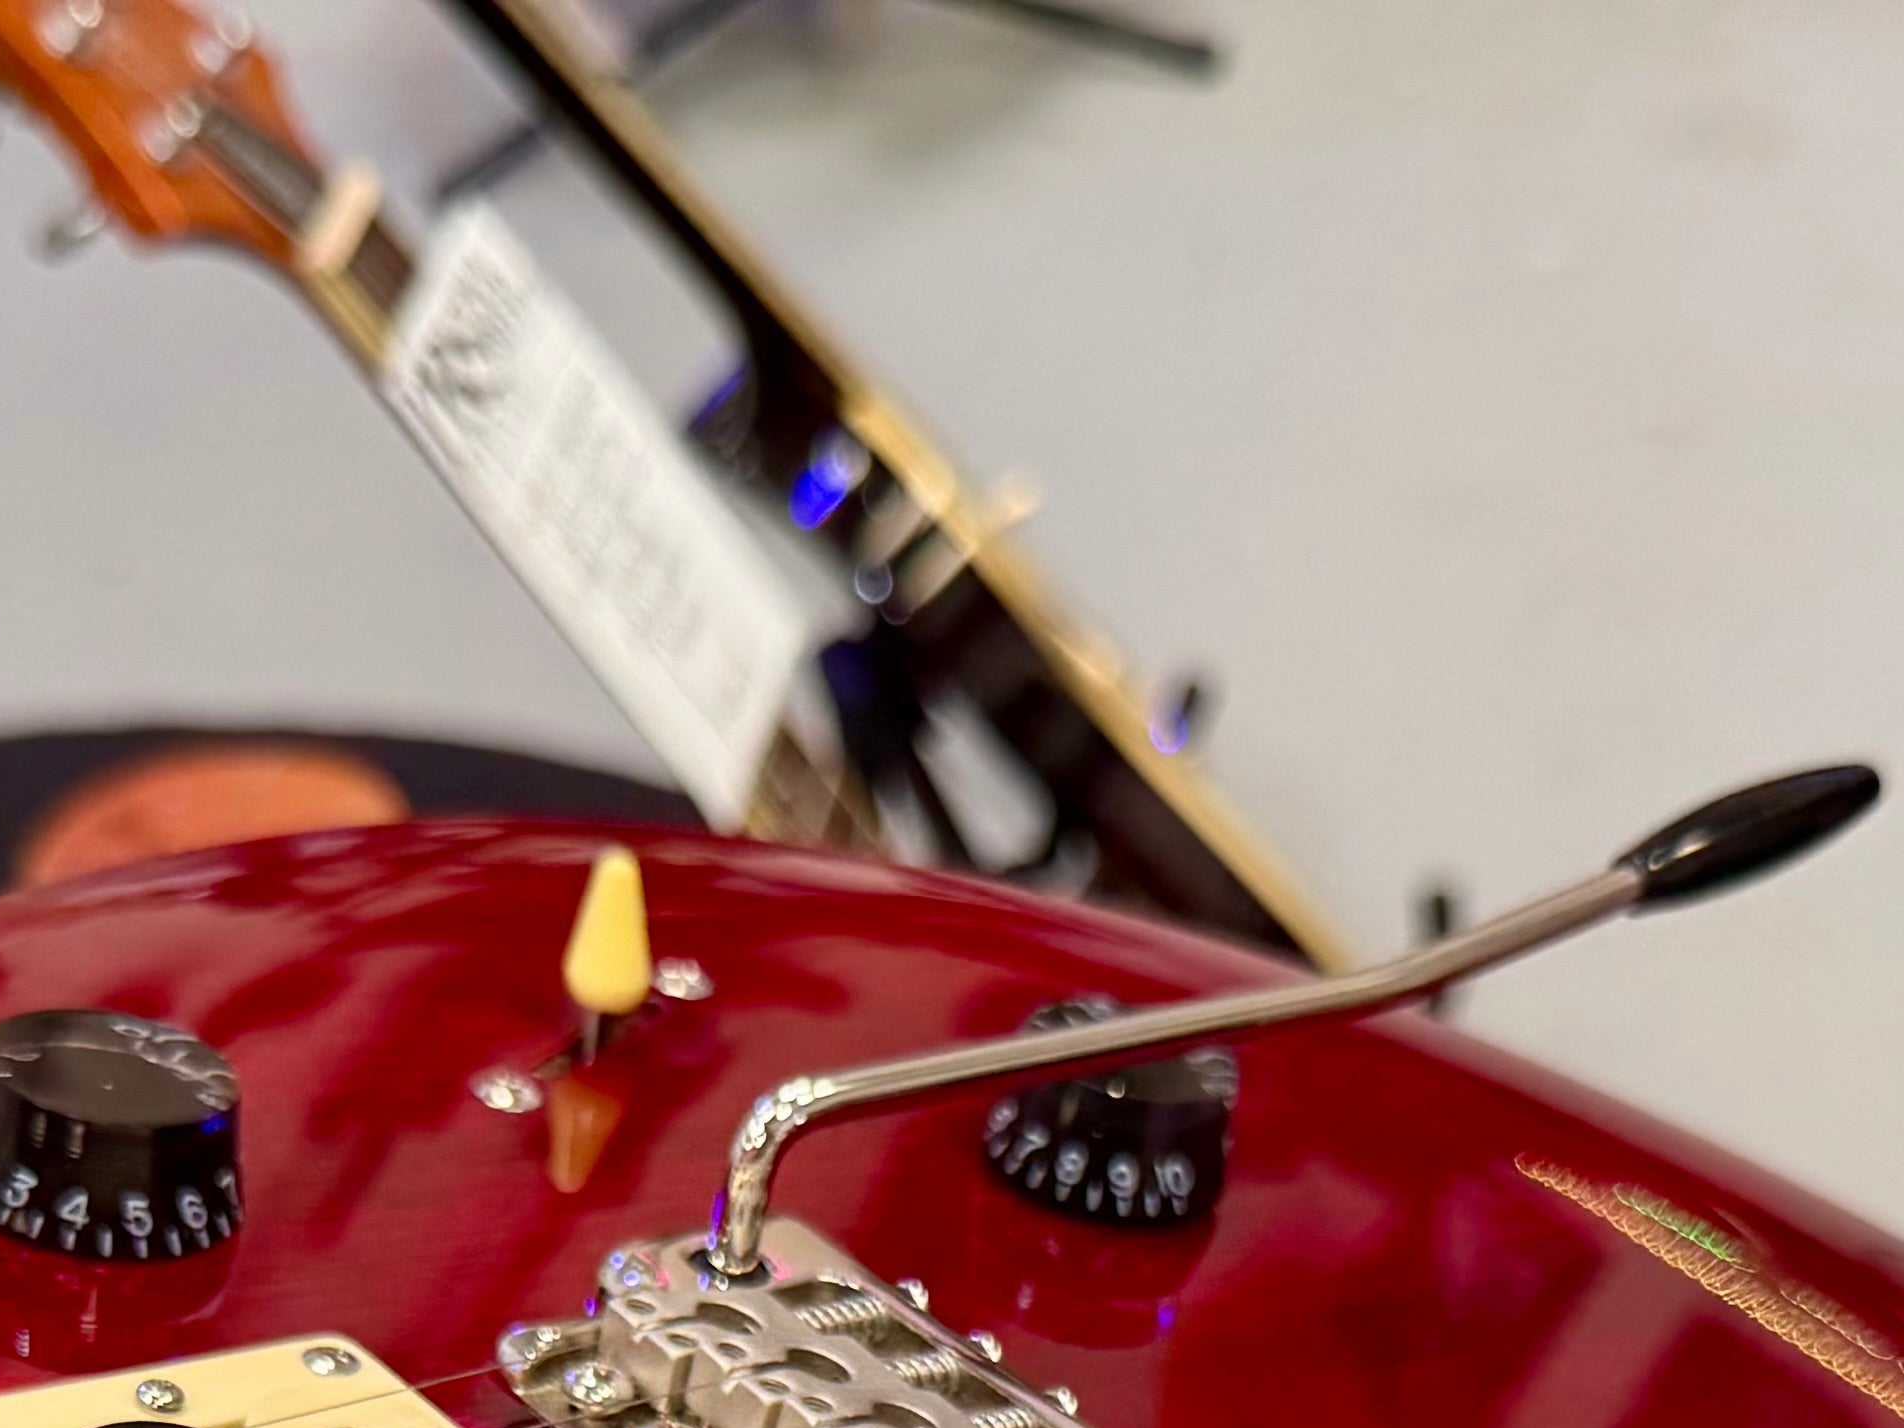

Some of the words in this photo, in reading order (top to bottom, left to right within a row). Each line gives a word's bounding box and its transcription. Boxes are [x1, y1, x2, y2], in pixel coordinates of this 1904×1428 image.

[1, 1165, 40, 1208] 3
[56, 1184, 91, 1231] 4
[121, 1190, 155, 1238] 5
[175, 1185, 209, 1230] 6
[1054, 1139, 1090, 1187] 8
[1107, 1151, 1140, 1198] 9
[1153, 1151, 1196, 1199] 10
